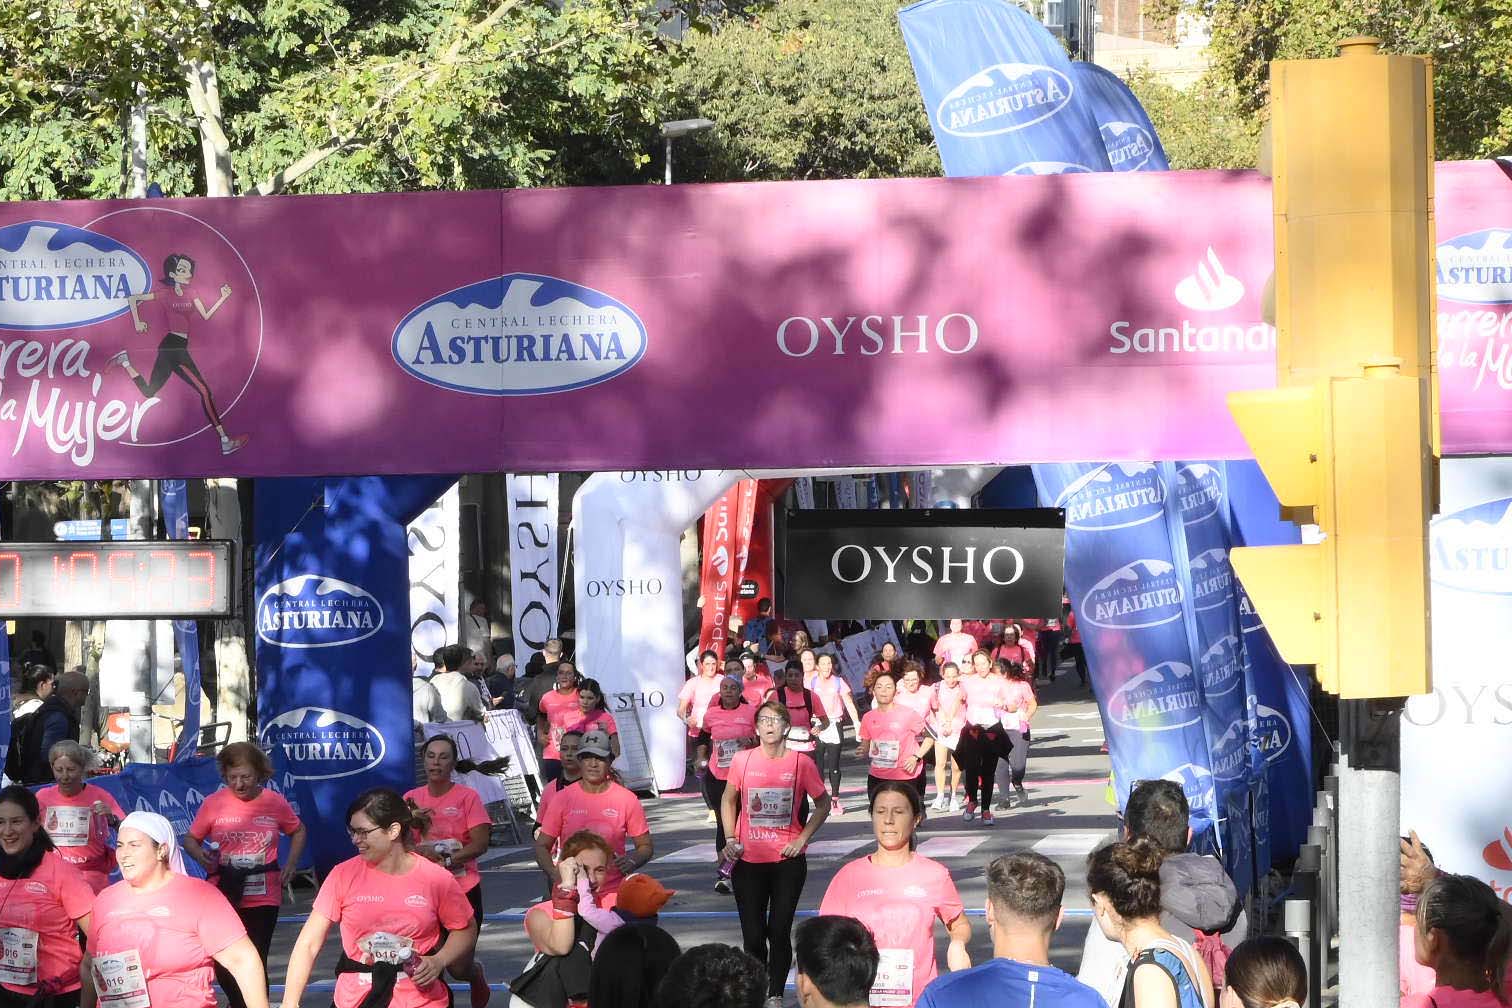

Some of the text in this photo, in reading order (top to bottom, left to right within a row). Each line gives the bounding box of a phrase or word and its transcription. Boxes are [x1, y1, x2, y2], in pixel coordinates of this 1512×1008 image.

[54, 256, 127, 269] LECHERA
[450, 314, 619, 331] CENTRAL LECHERA
[776, 313, 980, 358] OYSHO
[1109, 319, 1277, 354] Santand
[411, 320, 627, 366] ASTURIANA
[11, 374, 161, 467] Mujer
[831, 544, 1024, 586] OYSHO
[586, 577, 663, 598] OYSHO
[261, 605, 374, 632] ASTURIANA
[748, 829, 778, 841] SUMA
